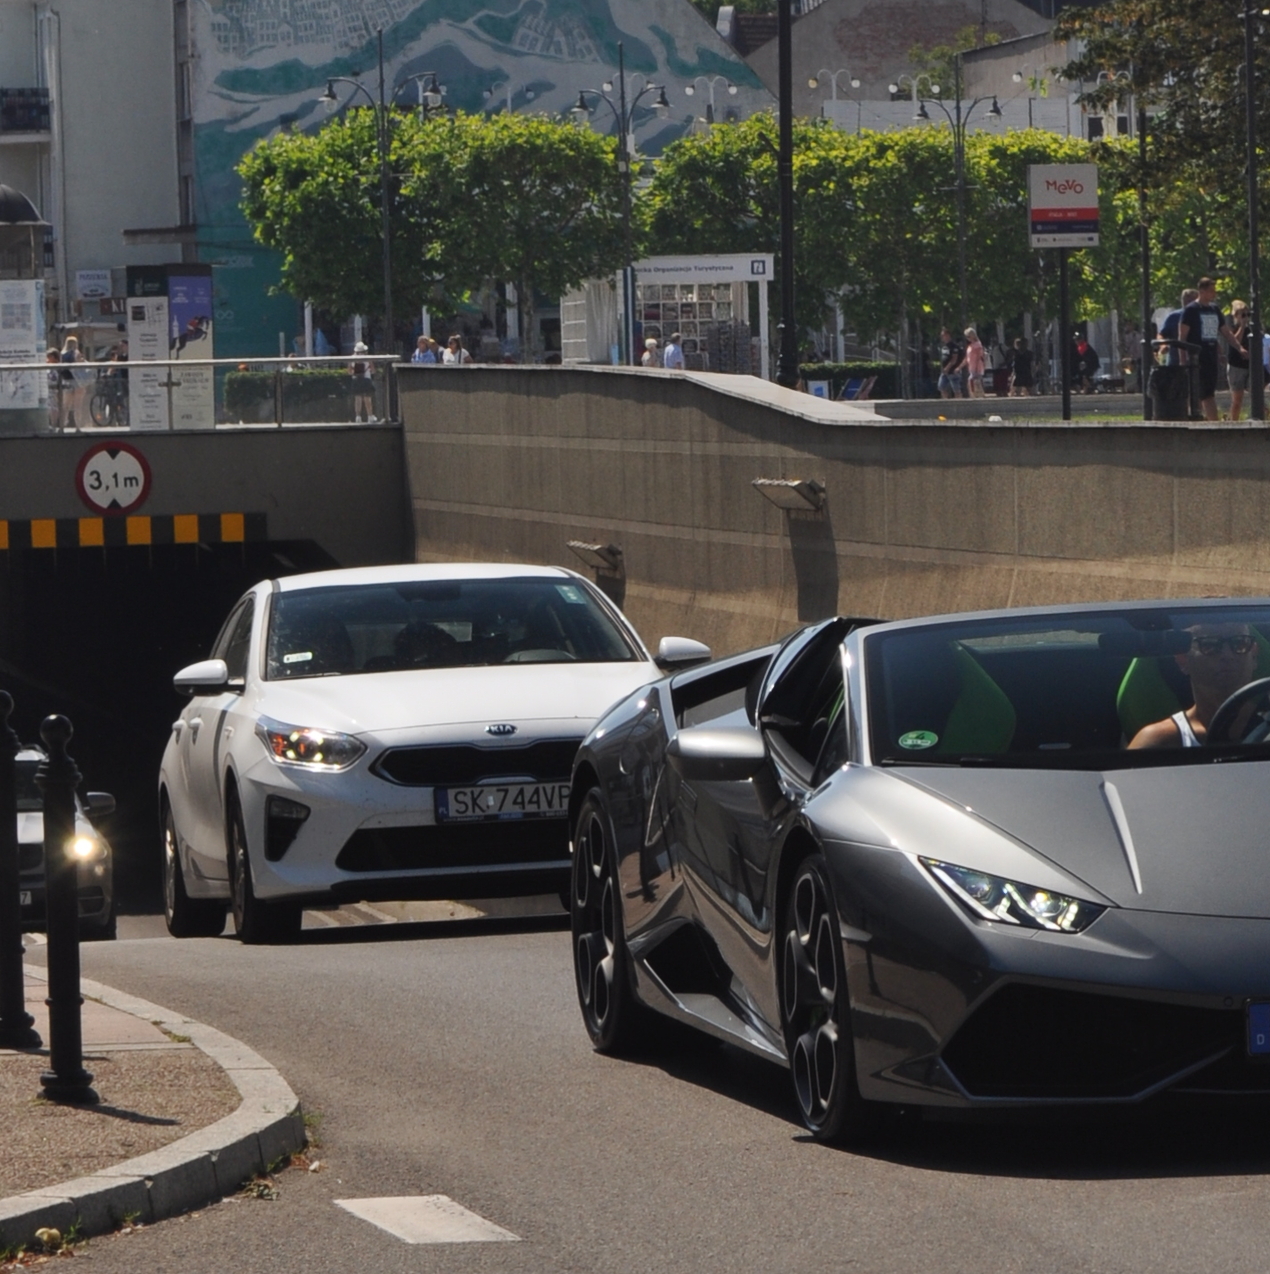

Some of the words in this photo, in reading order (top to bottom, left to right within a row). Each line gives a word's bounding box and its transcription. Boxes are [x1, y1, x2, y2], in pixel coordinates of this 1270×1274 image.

[634, 265, 652, 274] ocka
[653, 265, 692, 275] Organizacja
[490, 725, 513, 733] KIA
[454, 789, 488, 815] SK
[495, 784, 572, 813] 744VP
[1256, 1033, 1265, 1045] D
